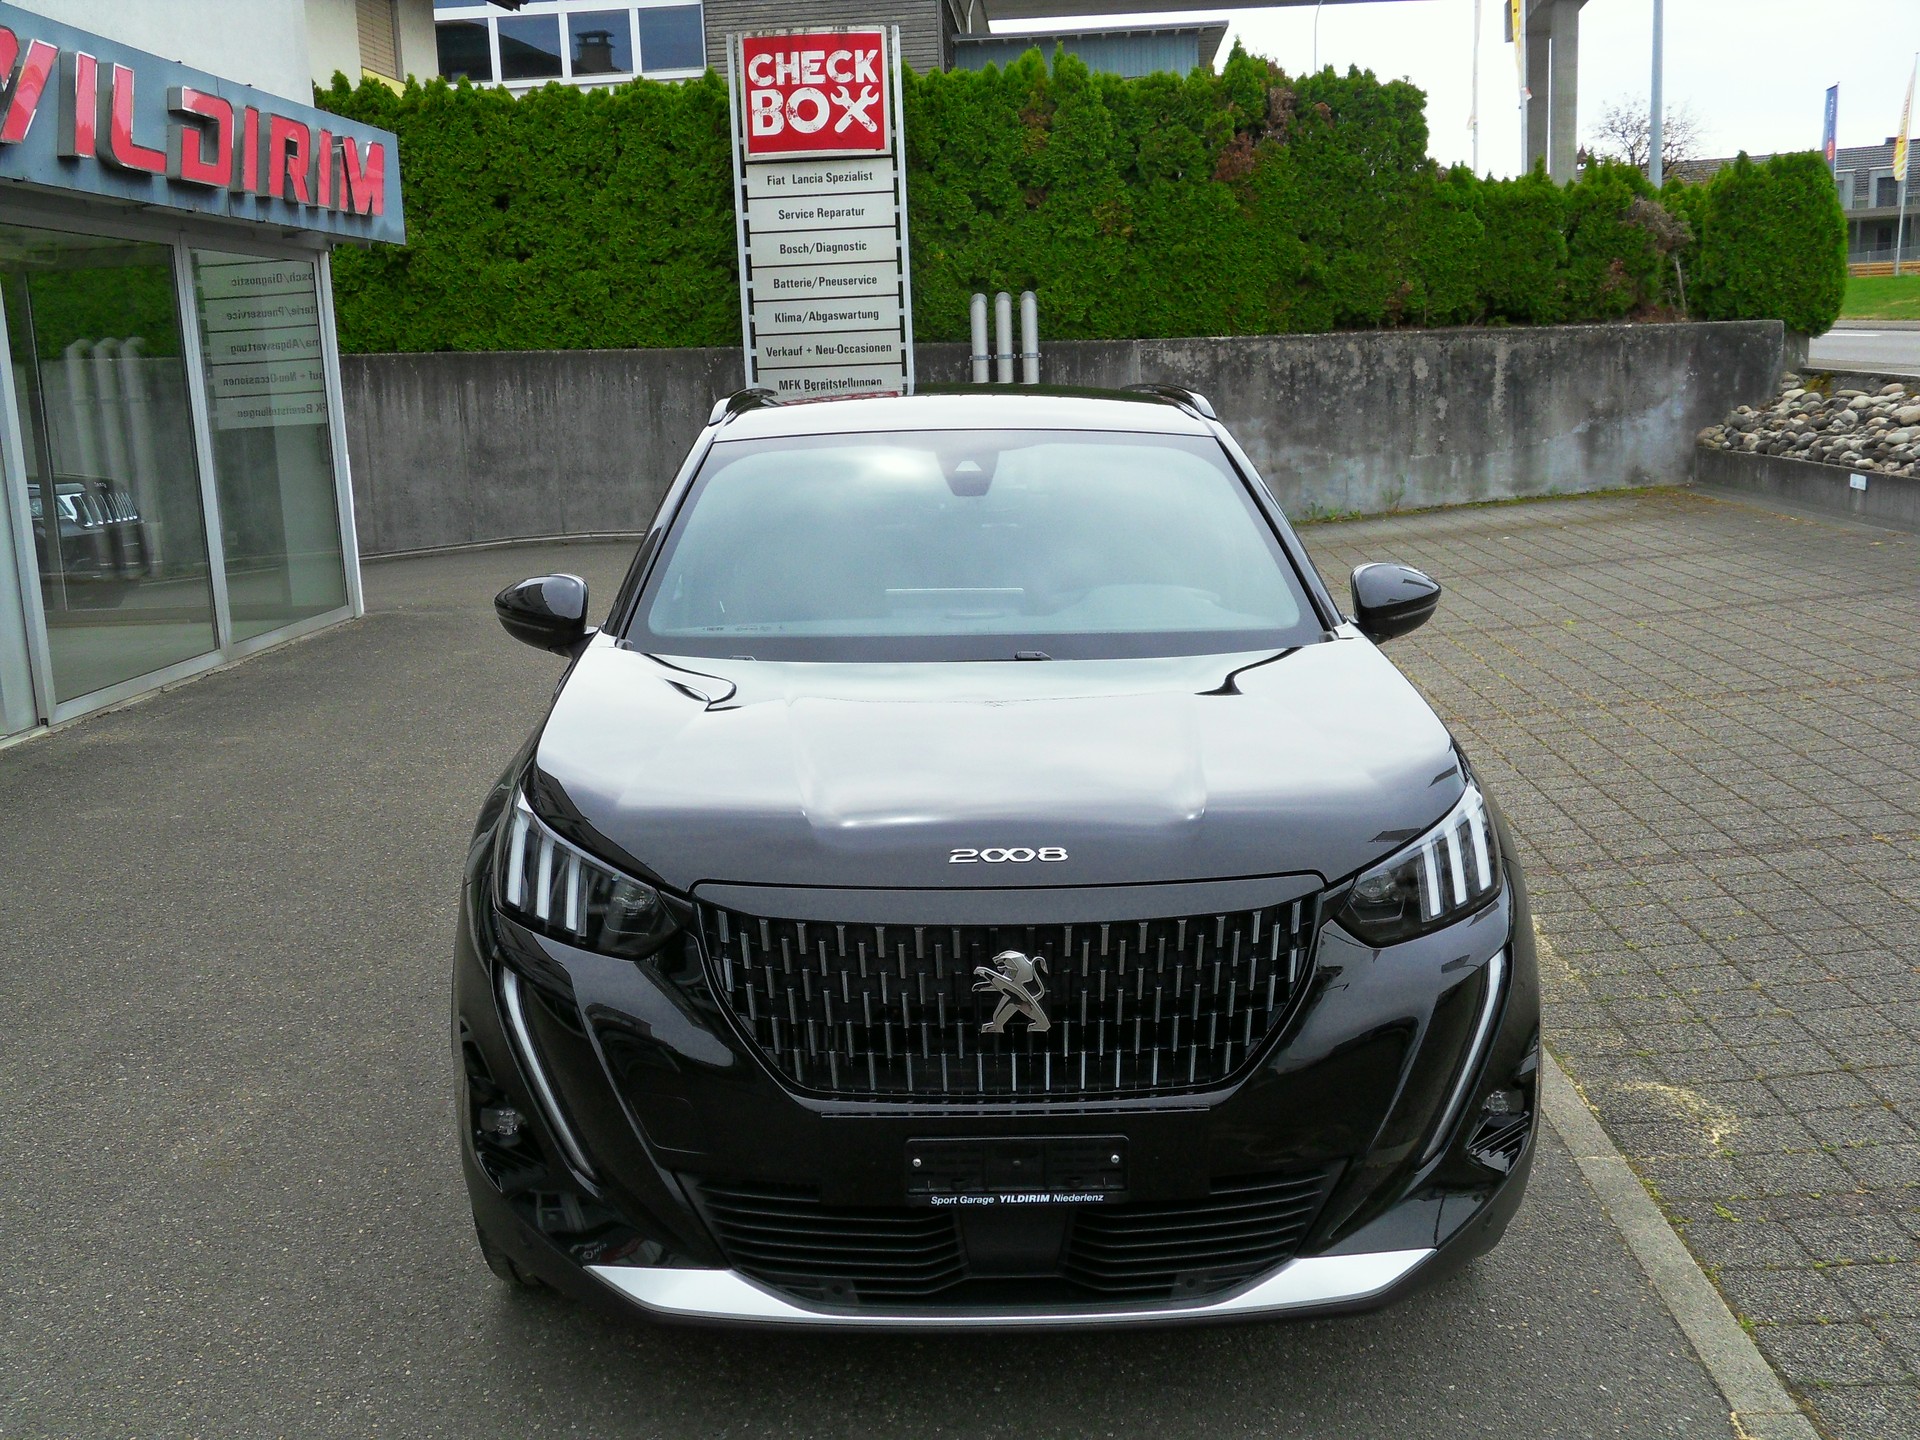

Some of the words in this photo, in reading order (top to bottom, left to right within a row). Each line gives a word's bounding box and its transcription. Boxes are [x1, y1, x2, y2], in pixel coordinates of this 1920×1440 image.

[748, 49, 879, 87] CHECK
[750, 85, 880, 137] BOX
[766, 175, 786, 186] Fiat
[792, 173, 823, 184] Lancia
[825, 171, 873, 185] Spezialist
[778, 209, 814, 220] Service
[817, 207, 865, 219] Reparatur
[779, 240, 867, 254] Bosch/Diagnostic
[773, 274, 877, 289] Batterie/Pneuservice
[774, 309, 879, 323] Klima/Abgaswartung
[766, 346, 803, 357] Verkauf
[815, 343, 892, 355] Neu-Occasionen
[778, 379, 802, 391] MFK
[948, 847, 1068, 863] 2008
[931, 1196, 957, 1205] Sport
[960, 1195, 994, 1205] Garage
[1000, 1194, 1050, 1203] YILDIRIM
[1053, 1193, 1104, 1202] Niederlenz
